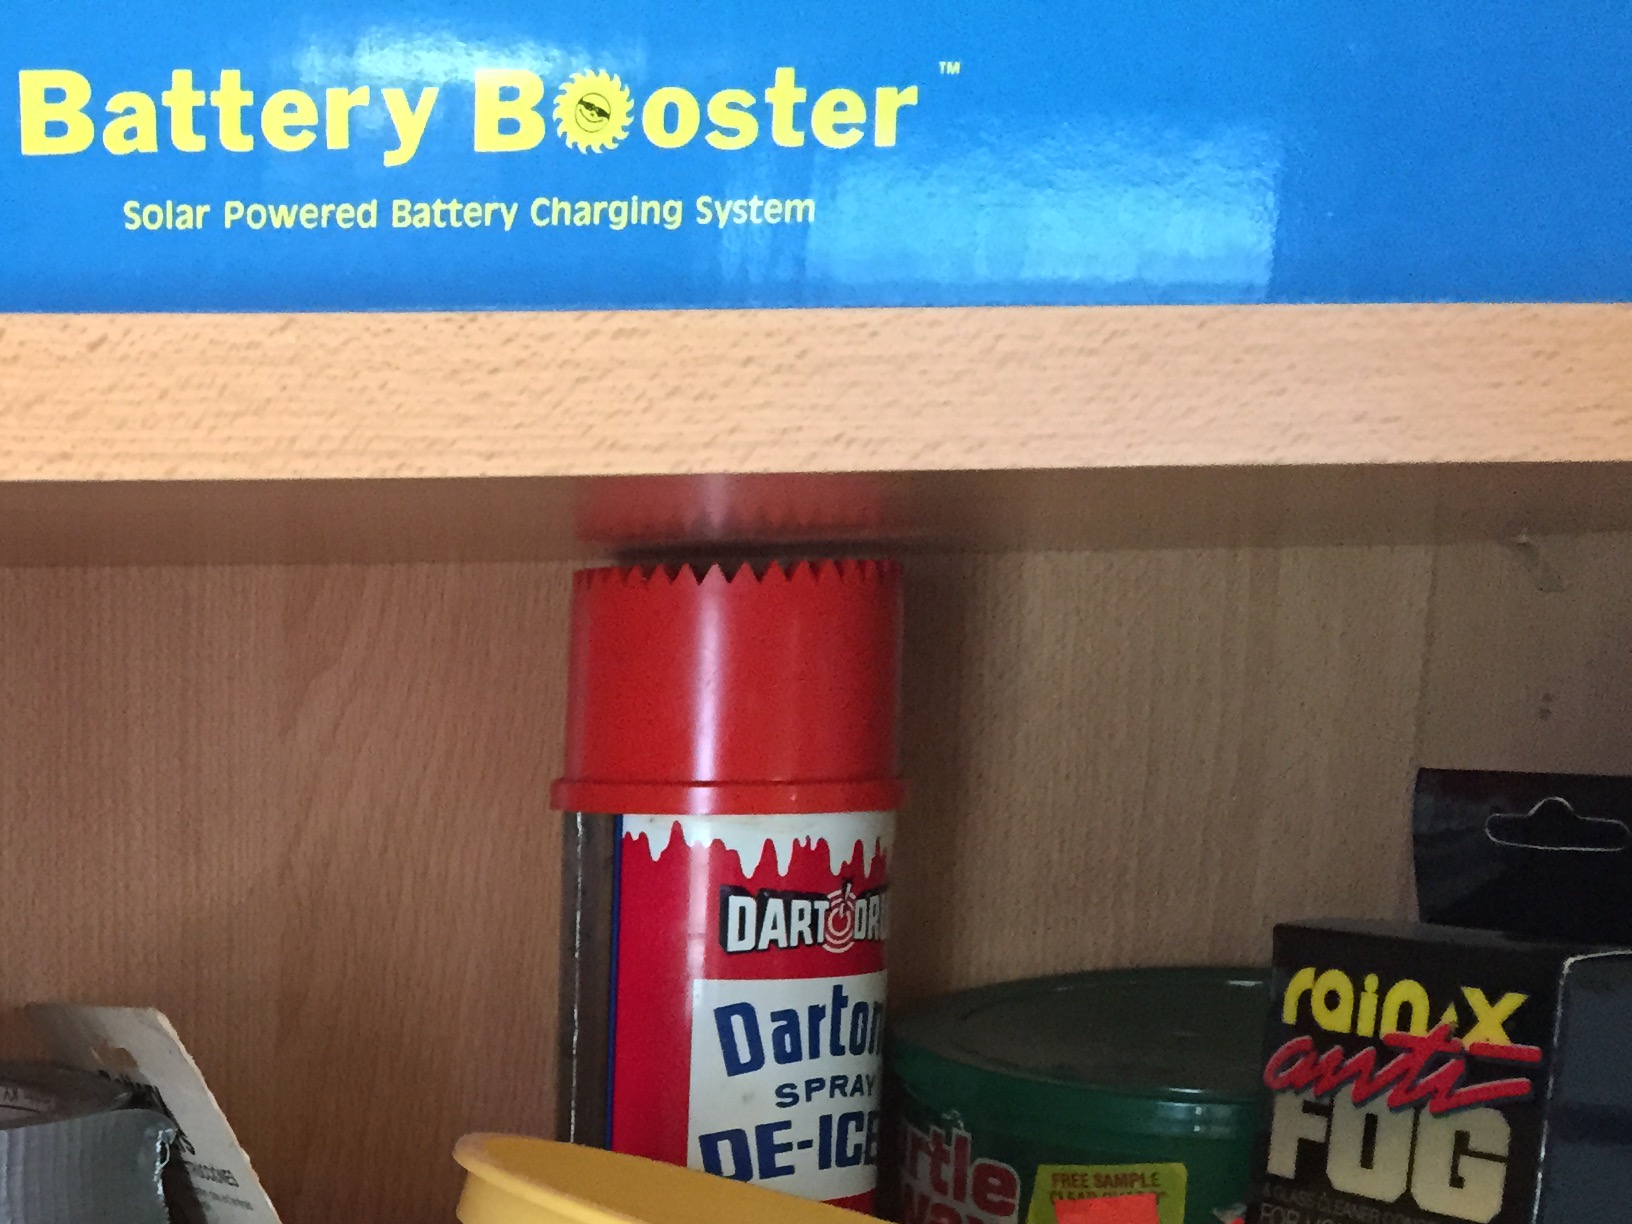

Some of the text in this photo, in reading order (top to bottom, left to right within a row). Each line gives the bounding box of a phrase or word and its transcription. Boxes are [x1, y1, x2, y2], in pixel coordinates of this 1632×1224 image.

[19, 65, 918, 166] Battery Booster
[123, 194, 816, 233] Solar Powered Battery Charging System
[775, 1074, 874, 1108] SPRAY
[906, 1127, 1020, 1217] rtle
[1051, 1171, 1161, 1189] FREE SAMPLE
[1267, 1084, 1511, 1224] FOG
